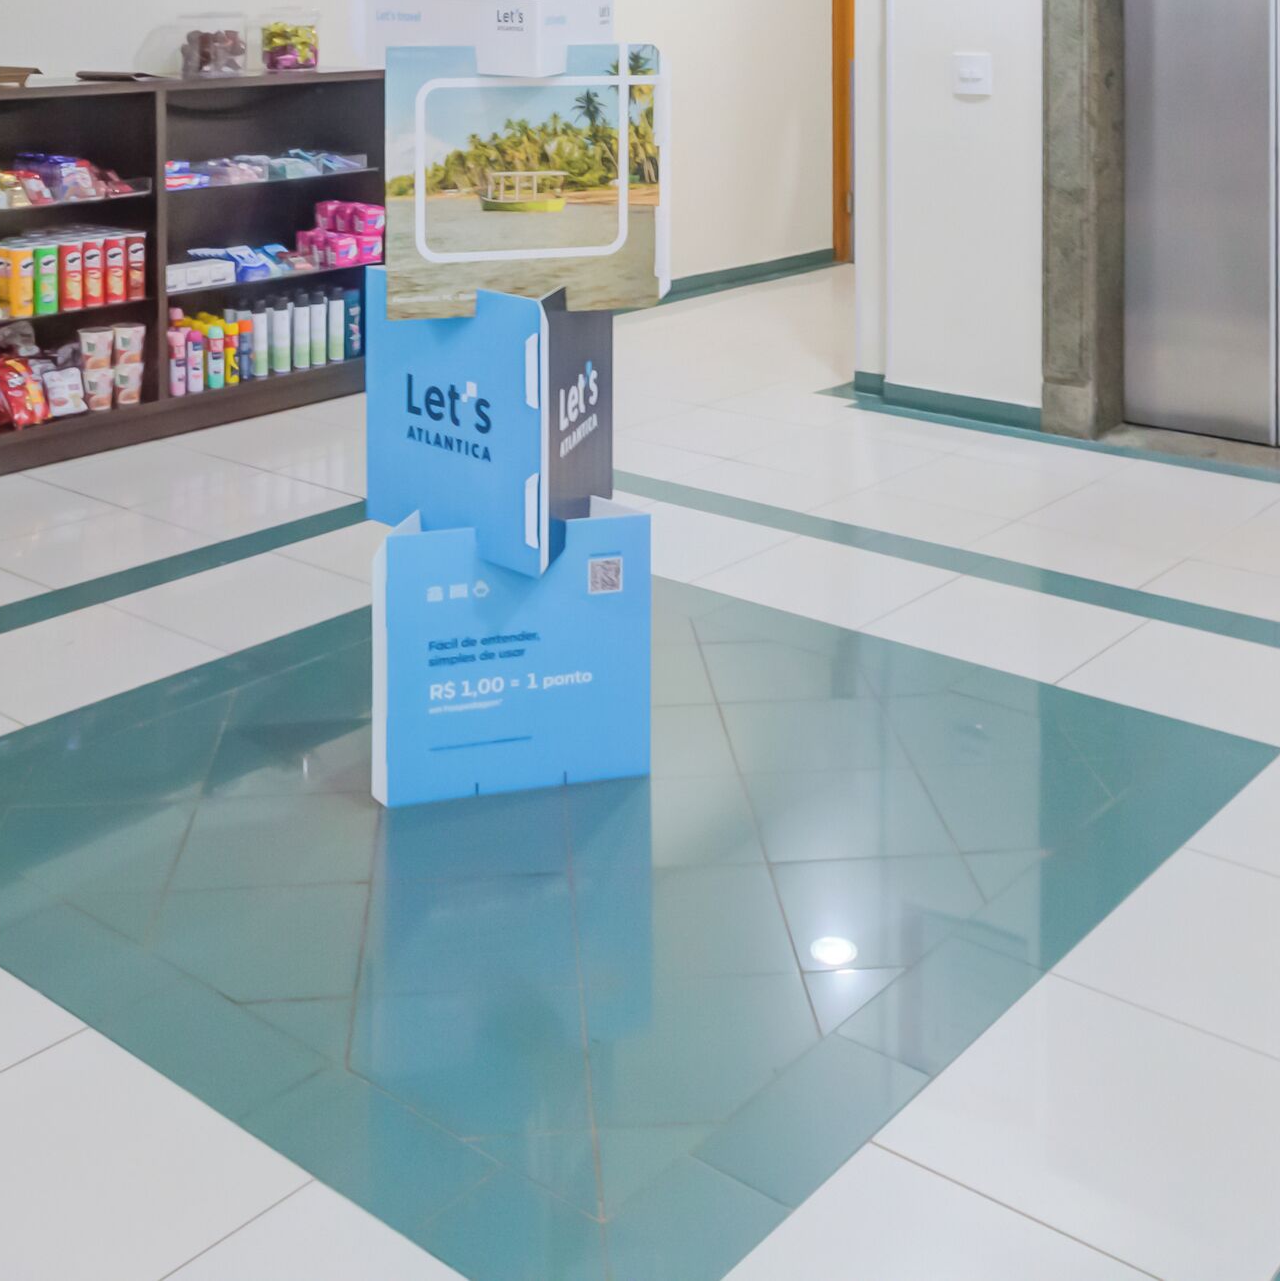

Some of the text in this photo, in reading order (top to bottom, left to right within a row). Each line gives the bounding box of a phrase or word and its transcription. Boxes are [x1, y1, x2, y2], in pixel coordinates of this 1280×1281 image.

[496, 8, 524, 24] Let's
[406, 372, 492, 434] Let's
[559, 359, 599, 431] Let's
[406, 424, 492, 463] ATLANTICA
[559, 413, 599, 458] ATLANTICA
[428, 648, 526, 667] simples de usar
[461, 636, 477, 648] de
[429, 681, 456, 701] R$
[461, 676, 505, 698] 1,00
[527, 672, 538, 689] 1
[542, 670, 593, 690] ponto
